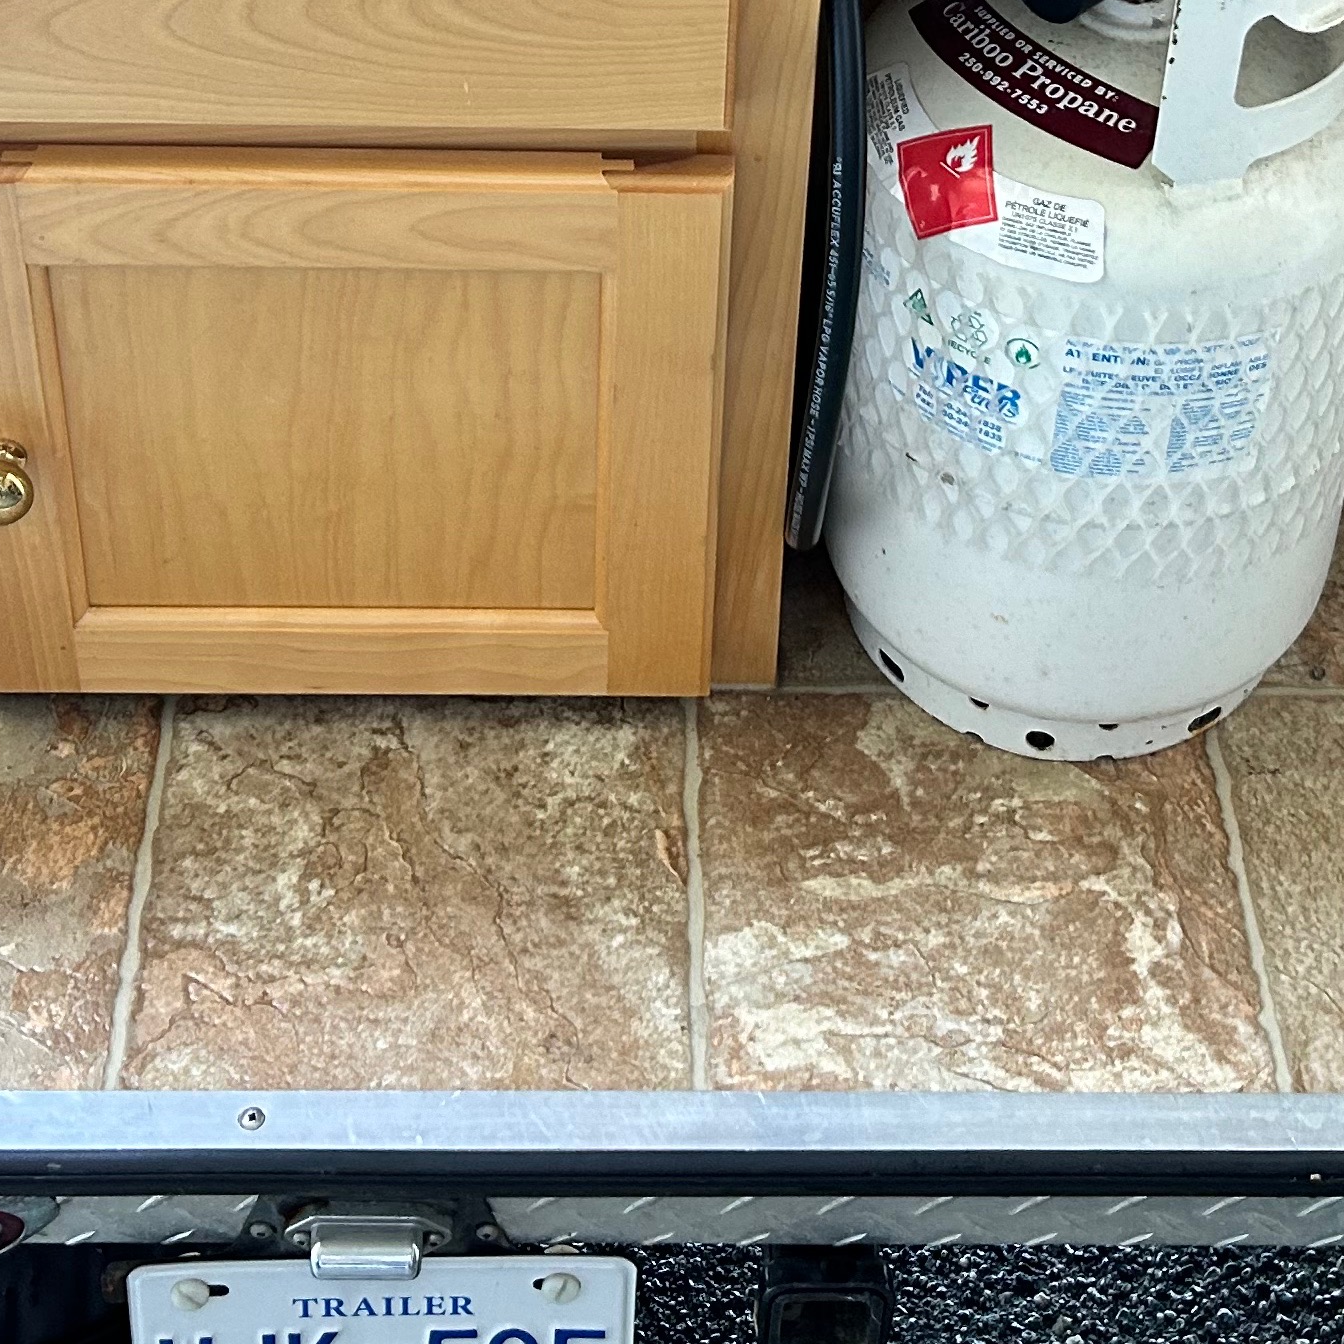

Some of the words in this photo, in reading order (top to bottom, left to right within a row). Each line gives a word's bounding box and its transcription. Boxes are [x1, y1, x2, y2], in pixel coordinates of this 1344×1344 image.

[943, 1, 1014, 67] Cariboo
[1011, 58, 1137, 133] Propane
[974, 5, 1016, 40] SUPPLIED
[1015, 39, 1033, 54] OR
[1032, 51, 1093, 88] SERVICED
[1094, 85, 1119, 103] BY:
[830, 178, 843, 248] ACCUFLEX
[1032, 197, 1052, 209] GAZ
[1053, 202, 1066, 212] DE
[814, 345, 830, 386] VAPOR
[947, 339, 992, 364] ECYCE
[809, 385, 823, 419] HOSE
[292, 1295, 475, 1319] TRAILER
